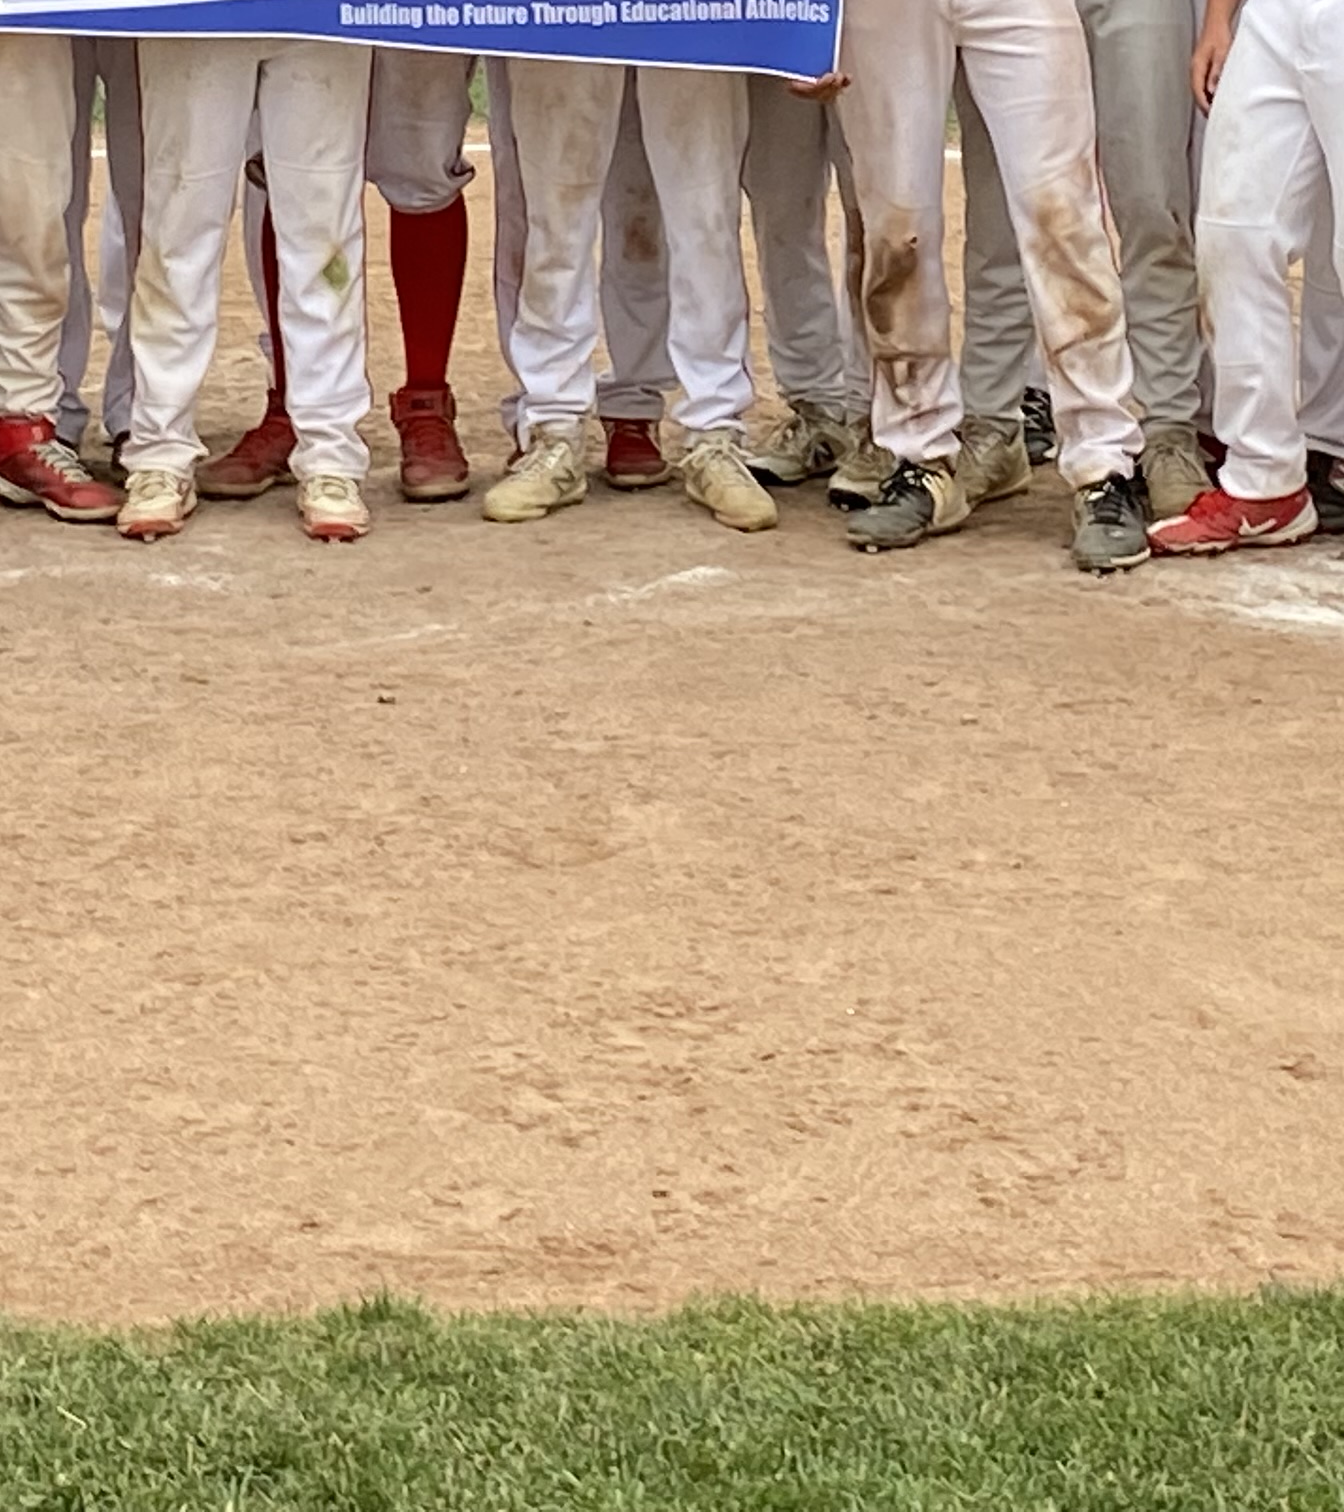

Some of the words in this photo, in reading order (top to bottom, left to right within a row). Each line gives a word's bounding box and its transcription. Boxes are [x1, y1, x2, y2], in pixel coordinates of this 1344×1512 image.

[339, 3, 423, 28] Building
[426, 3, 459, 26] the
[462, 2, 529, 26] Future
[532, 1, 617, 28] Through
